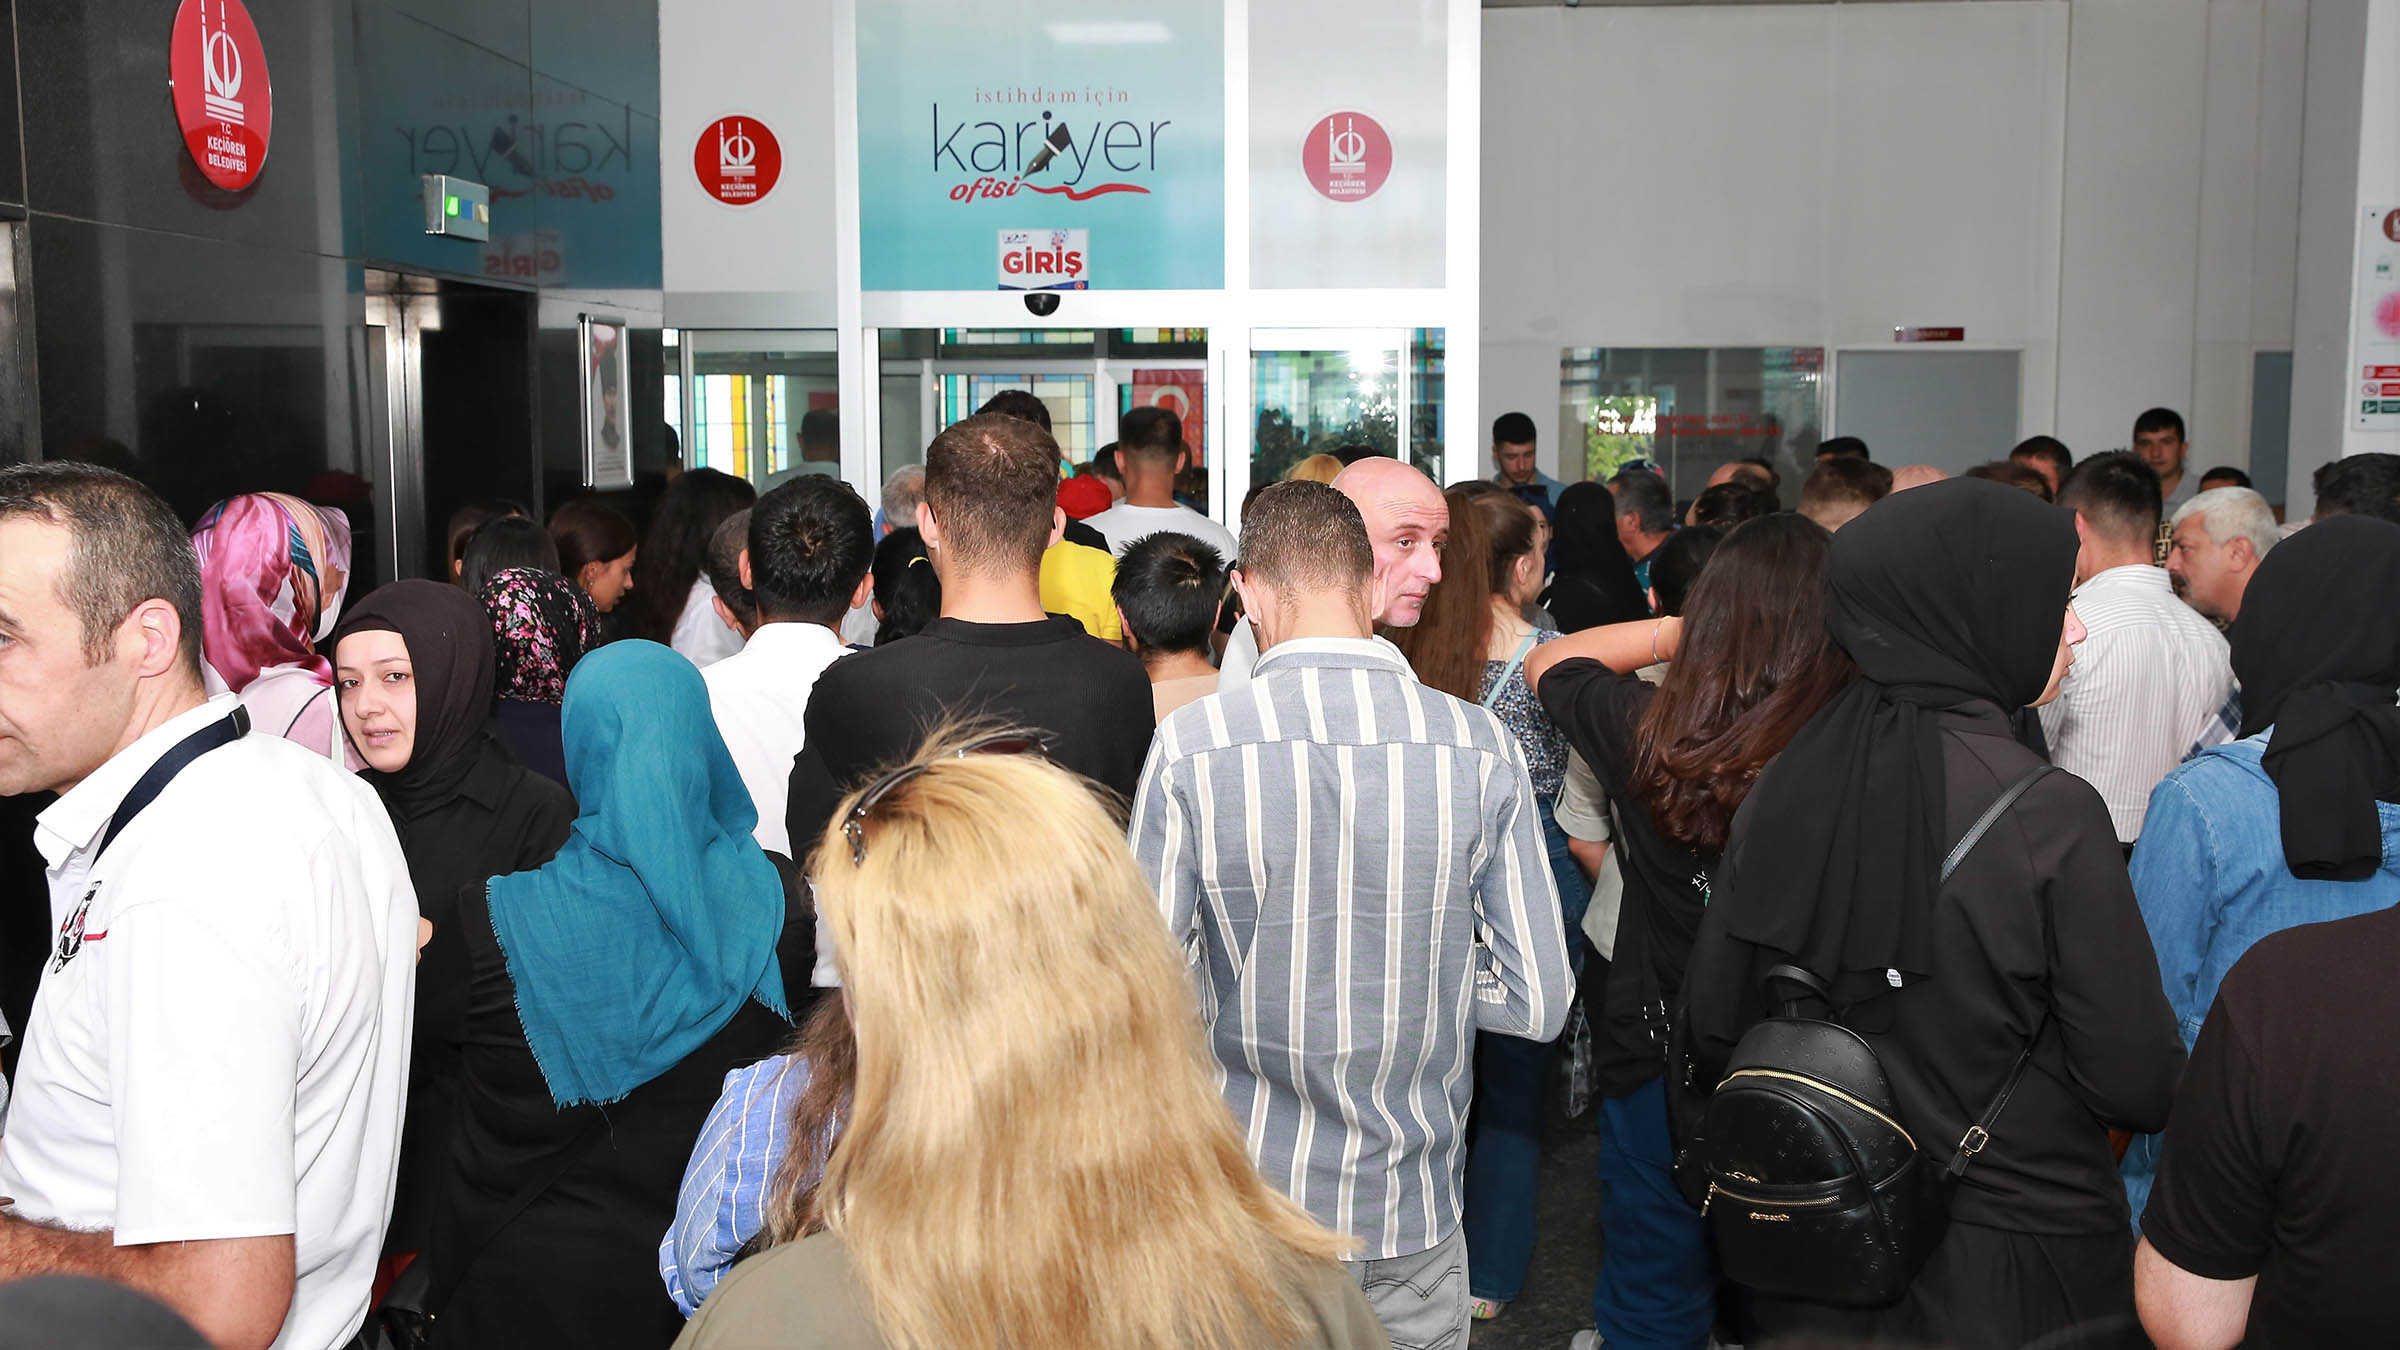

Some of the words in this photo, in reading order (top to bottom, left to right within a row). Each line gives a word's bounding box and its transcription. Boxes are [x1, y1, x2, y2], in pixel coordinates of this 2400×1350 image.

[974, 88, 1077, 104] istihdam
[1086, 88, 1129, 107] için
[221, 122, 233, 135] T.C.
[207, 135, 246, 157] KEÇİÖREN
[933, 102, 1171, 186] kariyer
[208, 153, 247, 173] BELEDİYESİ
[949, 175, 1021, 204] ofisi
[1003, 245, 1083, 278] GİRİŞ
